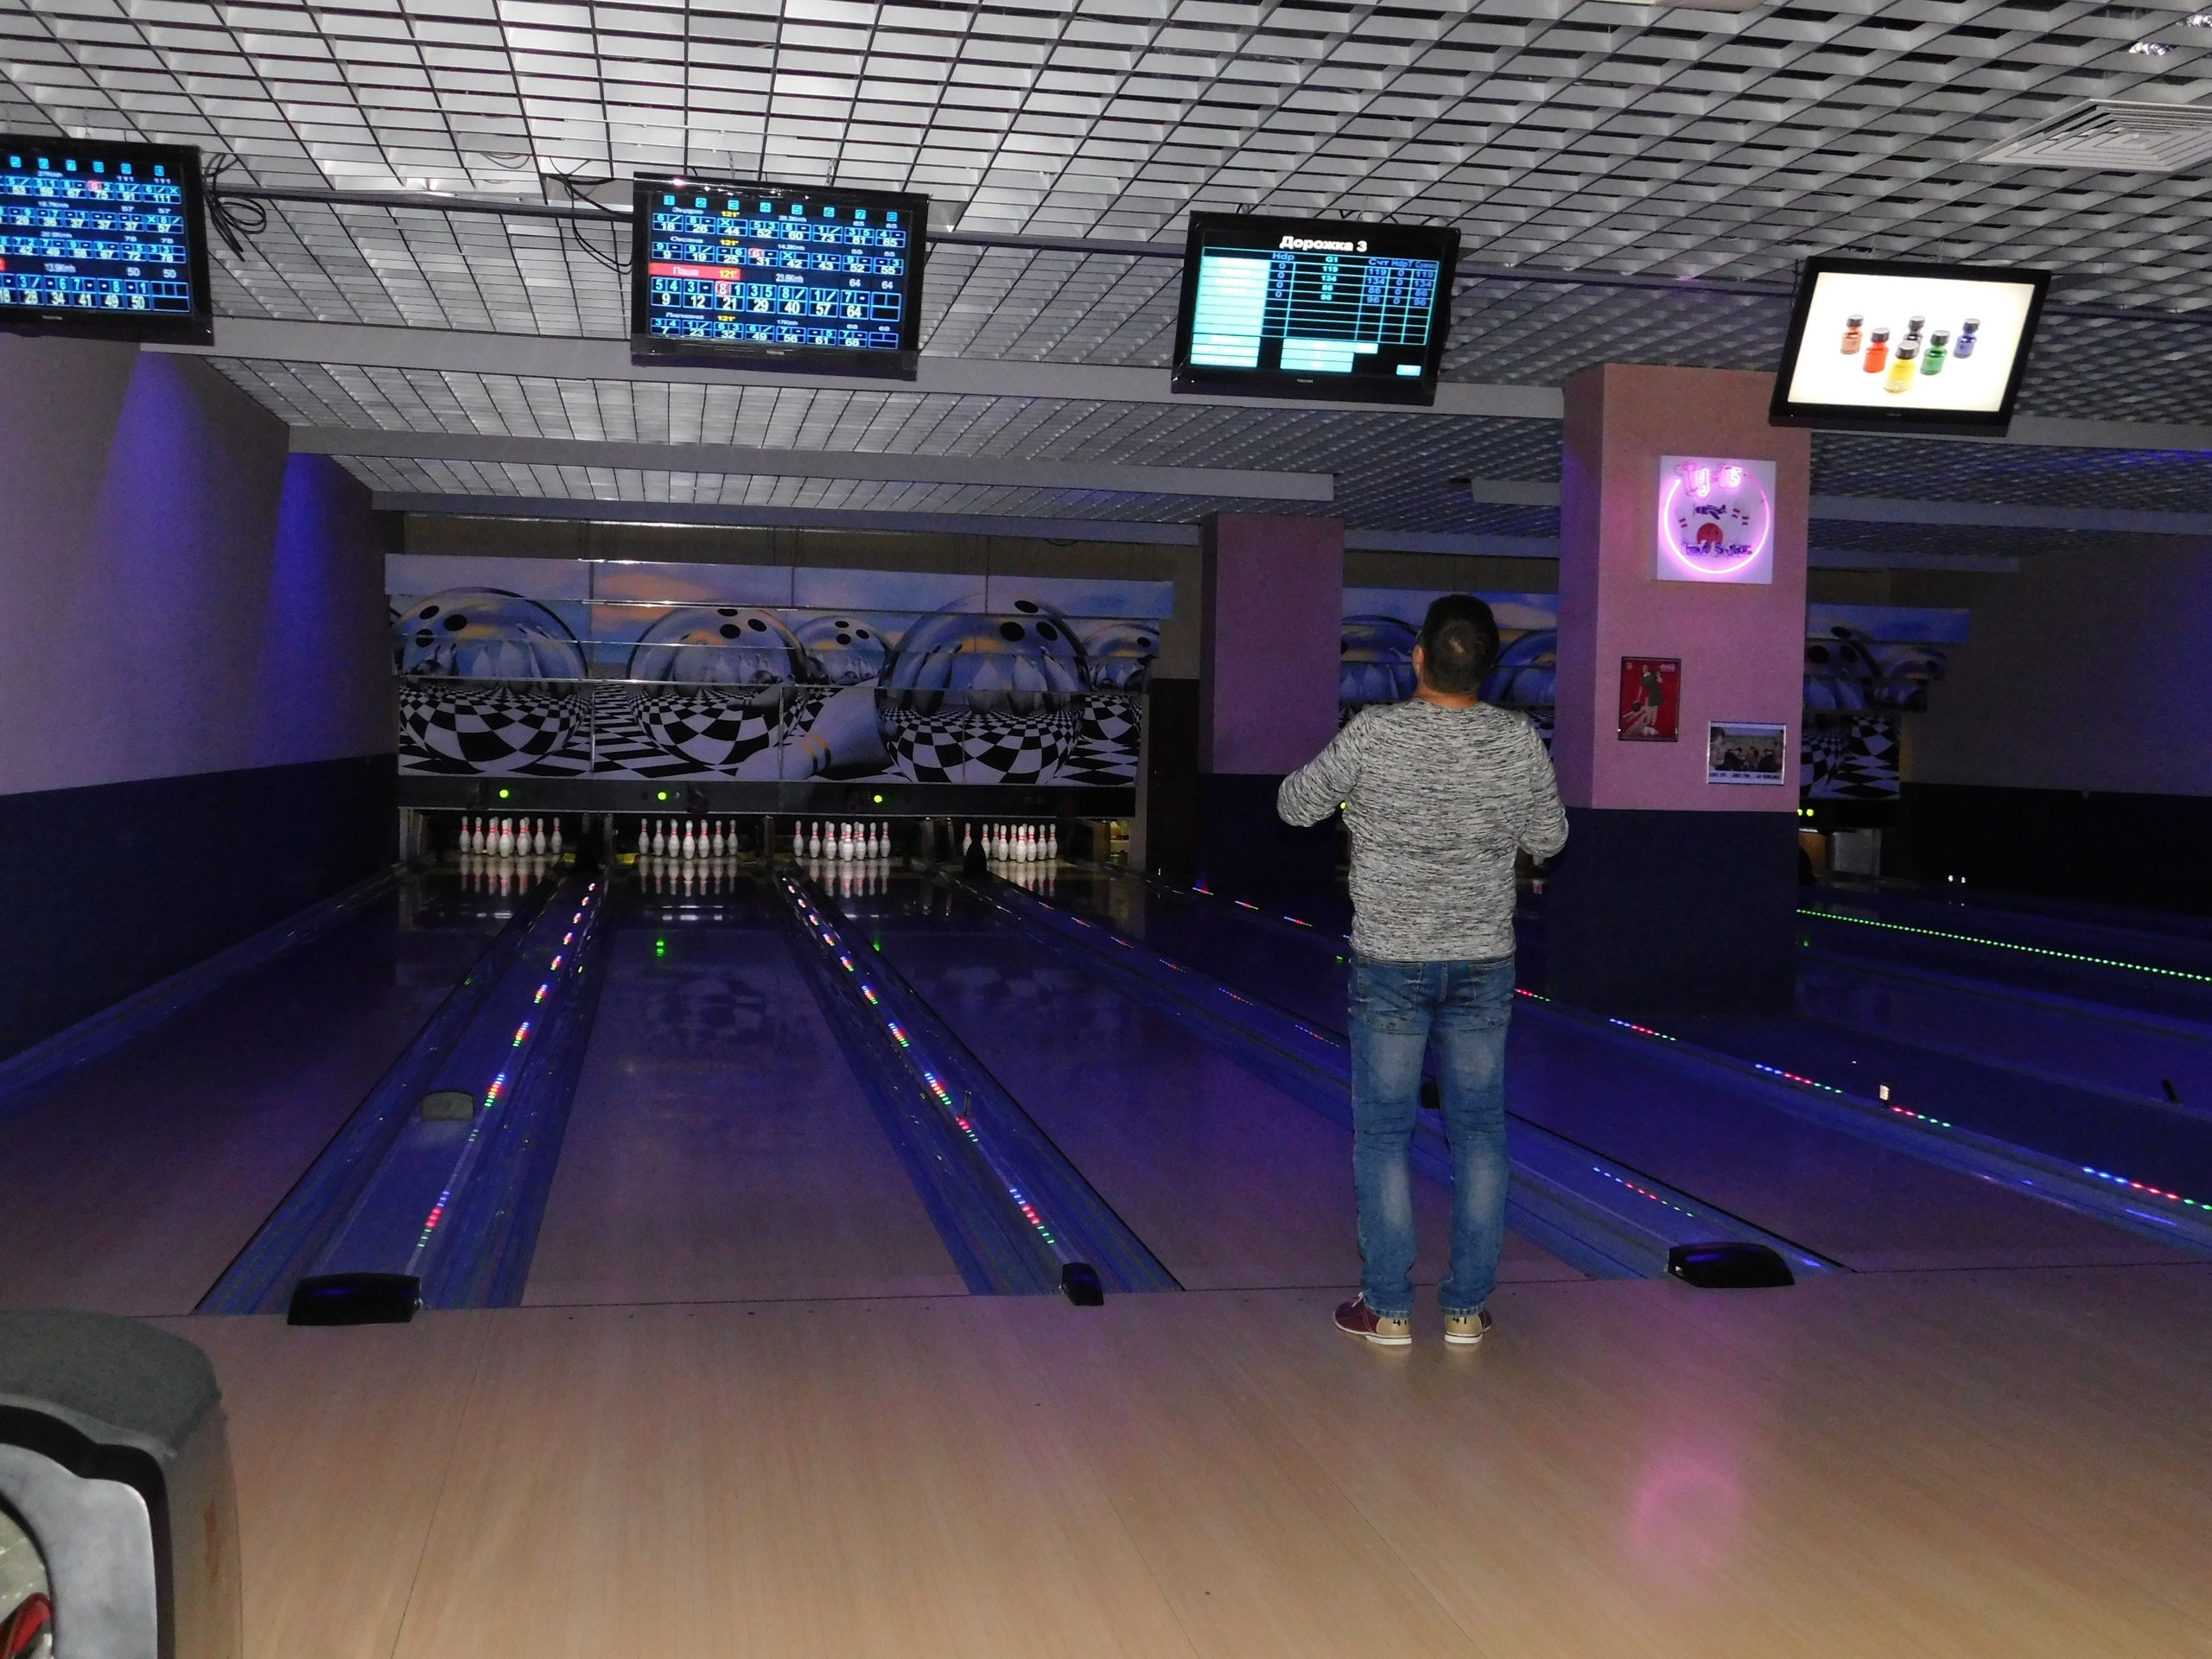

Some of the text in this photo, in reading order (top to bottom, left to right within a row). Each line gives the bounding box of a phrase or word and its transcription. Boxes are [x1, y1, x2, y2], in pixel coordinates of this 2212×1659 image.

[19, 246, 33, 255] 42
[1280, 236, 1367, 252] Дорожка 3
[1272, 252, 1294, 261] Hdp
[127, 267, 176, 278] 50 50
[672, 266, 699, 276] Паша
[849, 278, 861, 287] 64
[881, 281, 893, 289] 64
[20, 276, 27, 287] 3
[60, 278, 66, 289] 6
[74, 279, 79, 290] 7
[113, 281, 119, 292] 8
[656, 280, 853, 302] 5 4 3 8 1 3 5 8 1 7
[51, 292, 65, 304] 34
[79, 294, 92, 306] 41
[105, 295, 118, 308] 49
[131, 296, 145, 308] 50
[662, 294, 861, 318] 9 12 21 29 40 57 64
